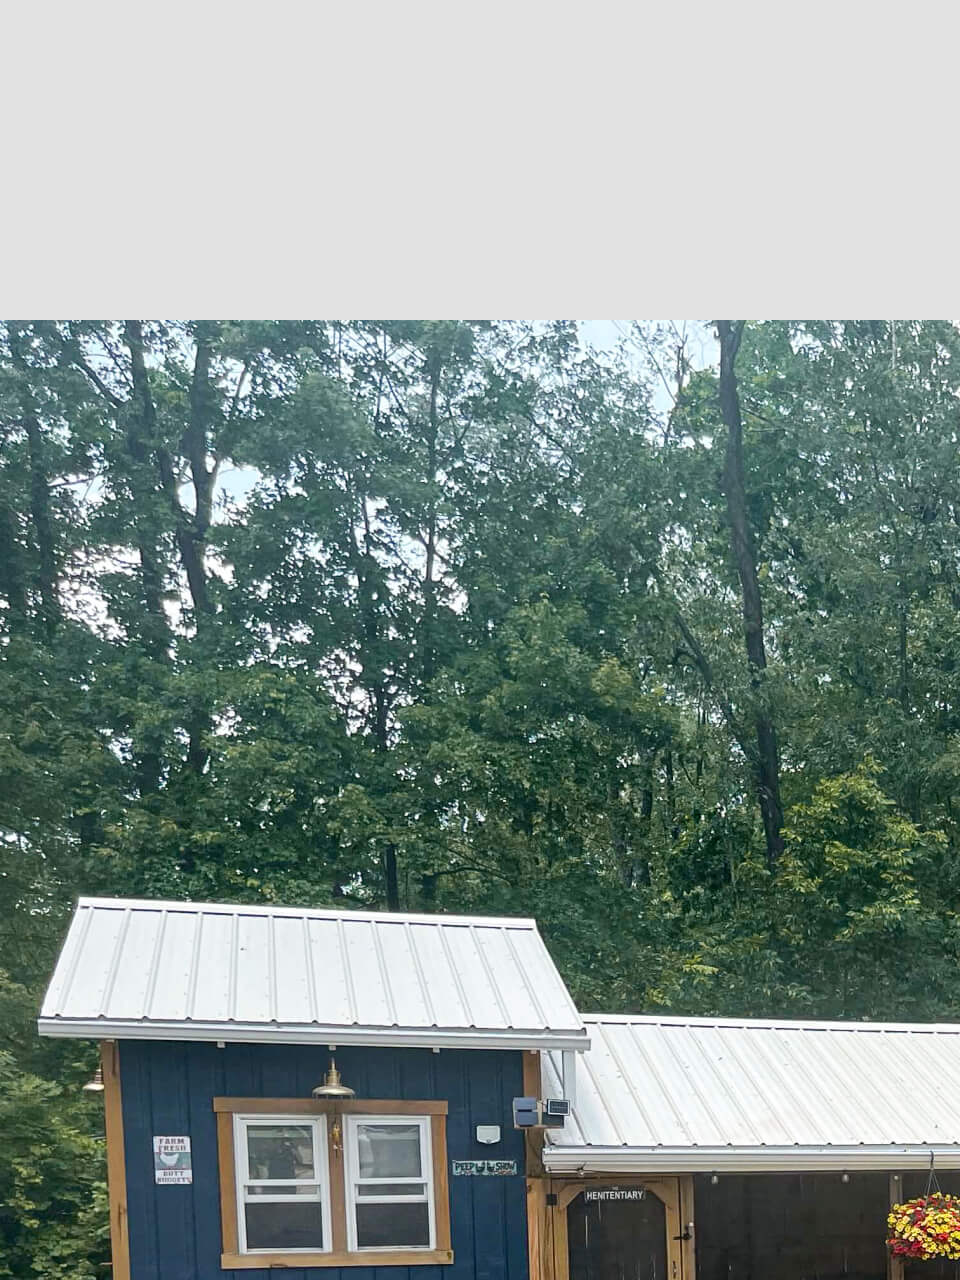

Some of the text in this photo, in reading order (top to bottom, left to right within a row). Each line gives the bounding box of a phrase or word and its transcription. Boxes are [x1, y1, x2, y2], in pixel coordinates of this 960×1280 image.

[455, 1162, 517, 1171] PEEP SHOW
[586, 1190, 644, 1200] HENITENTIARY
